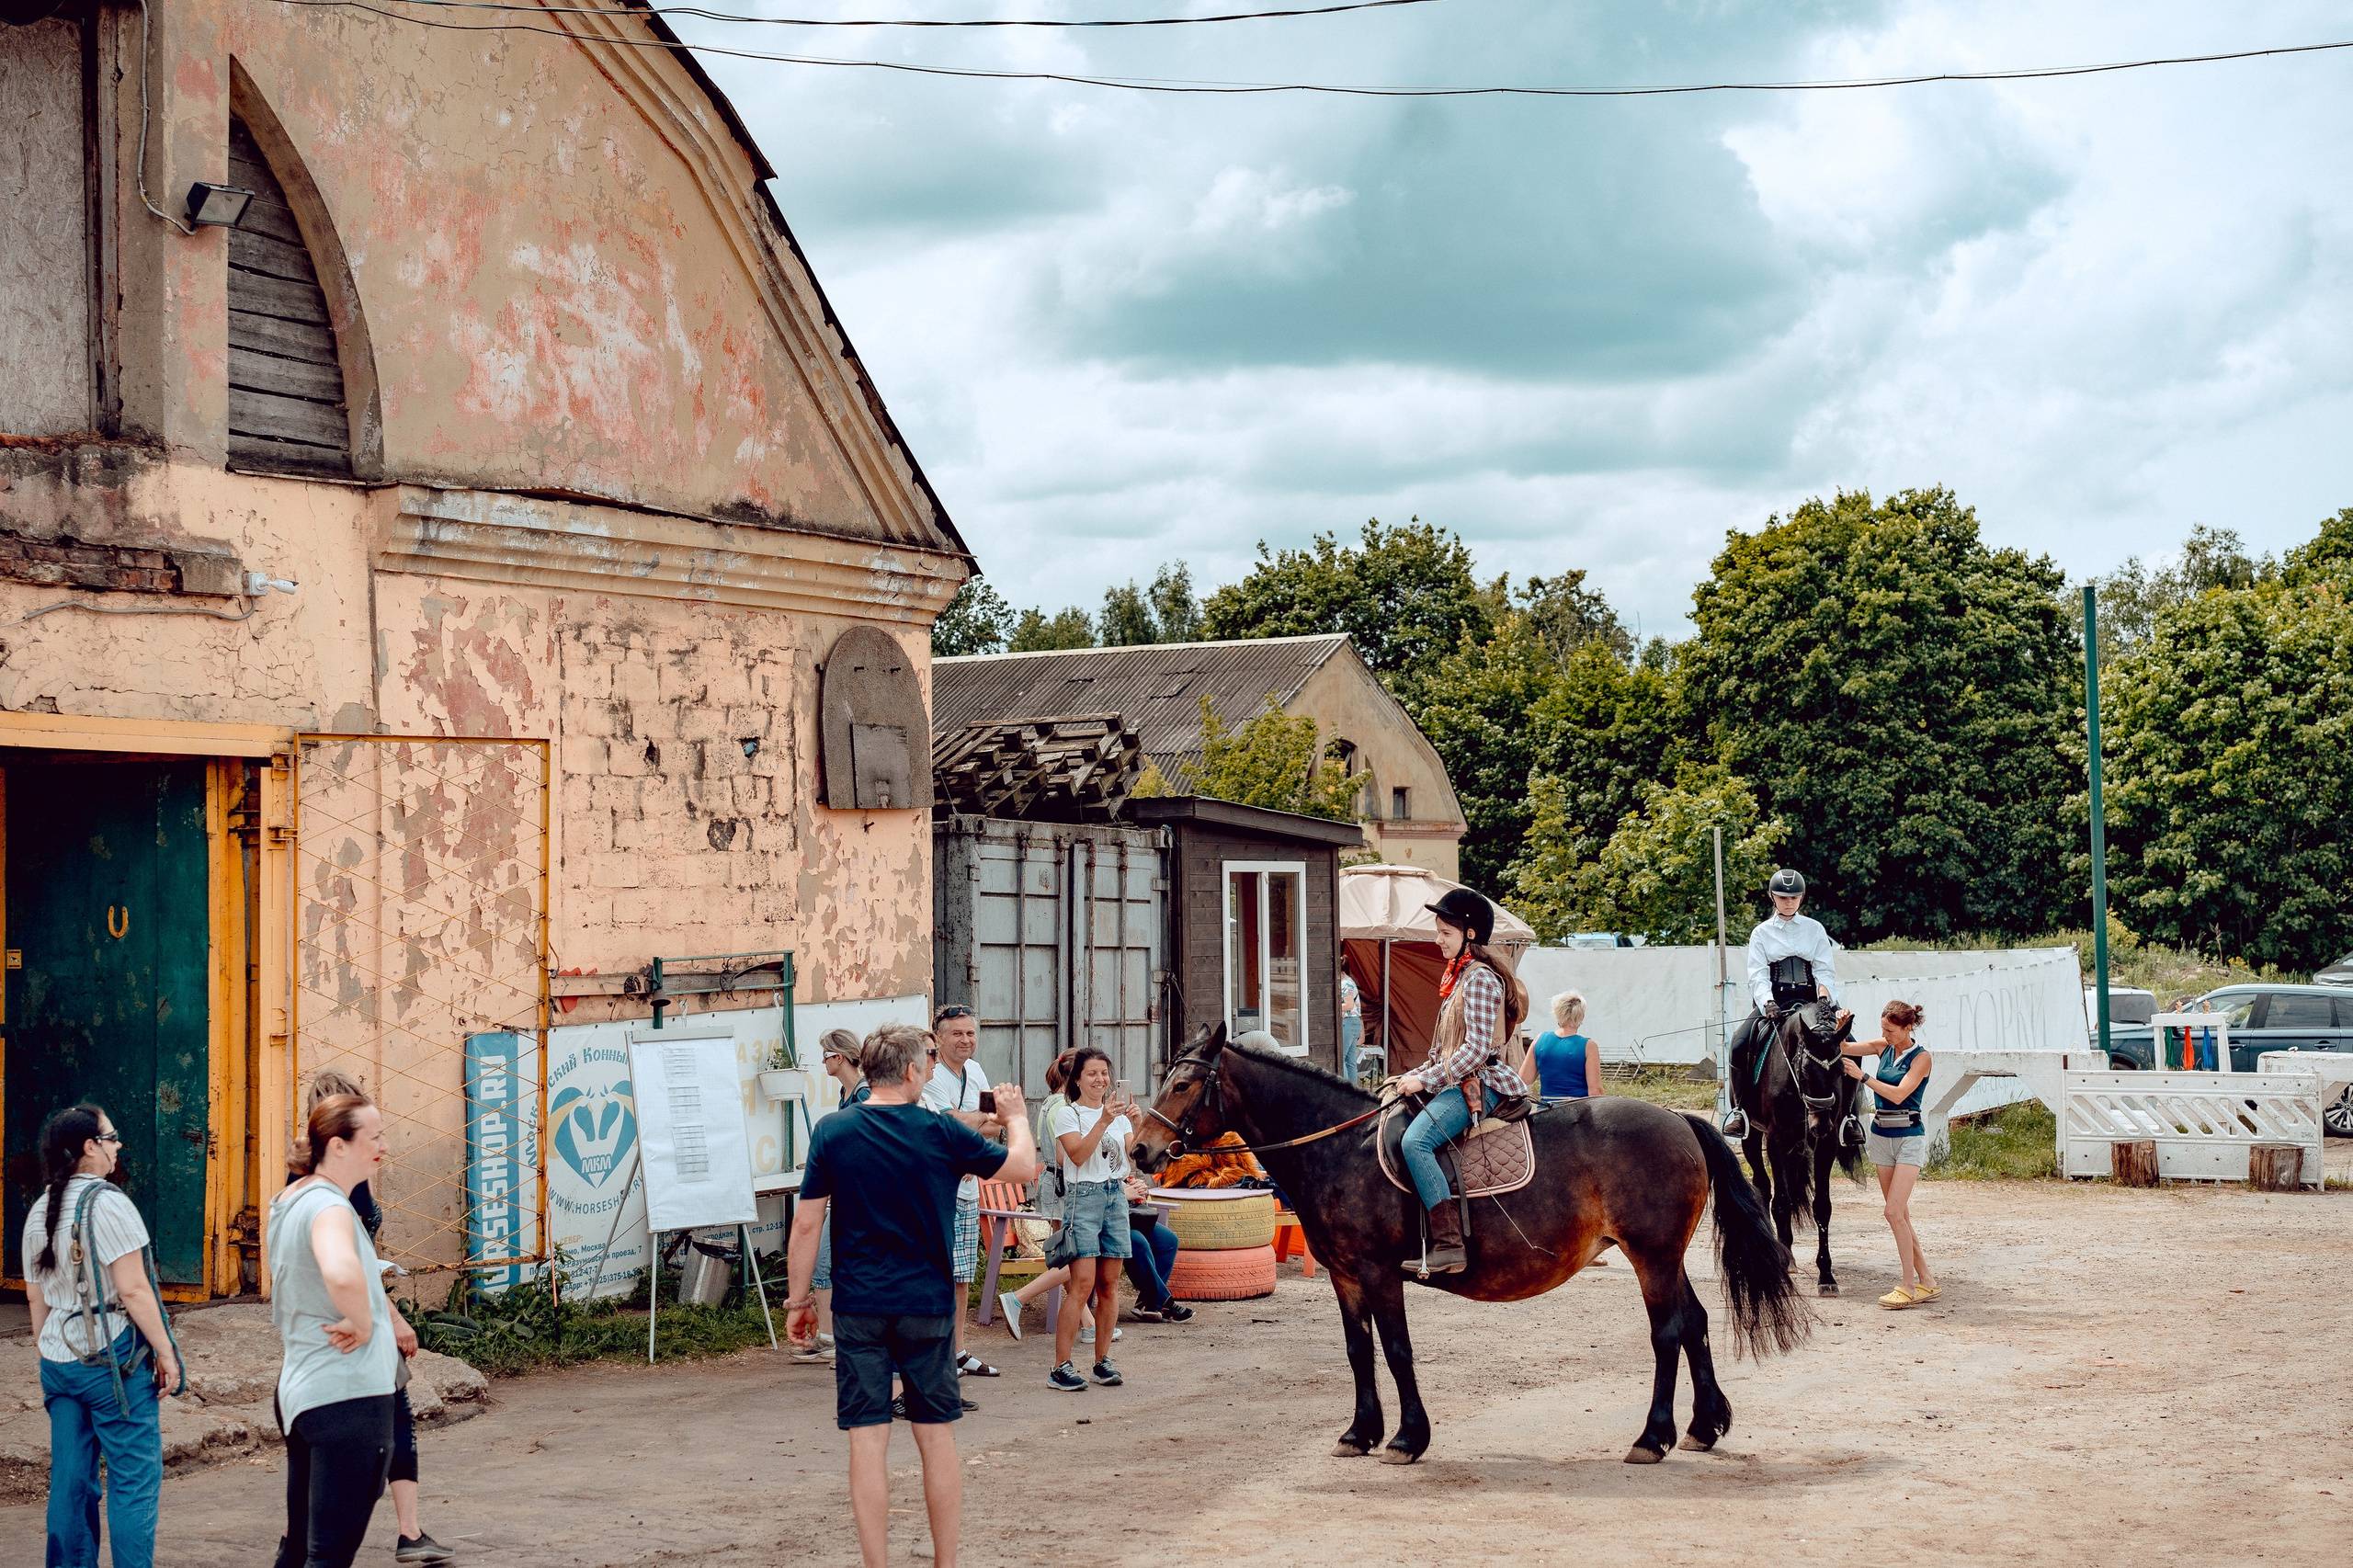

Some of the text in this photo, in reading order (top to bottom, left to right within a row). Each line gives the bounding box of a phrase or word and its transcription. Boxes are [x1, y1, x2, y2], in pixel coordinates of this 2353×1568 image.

[581, 1153, 612, 1175] МКМ
[752, 1226, 765, 1234] стр.
[581, 1243, 607, 1253] Москва
[638, 1244, 642, 1254] 7
